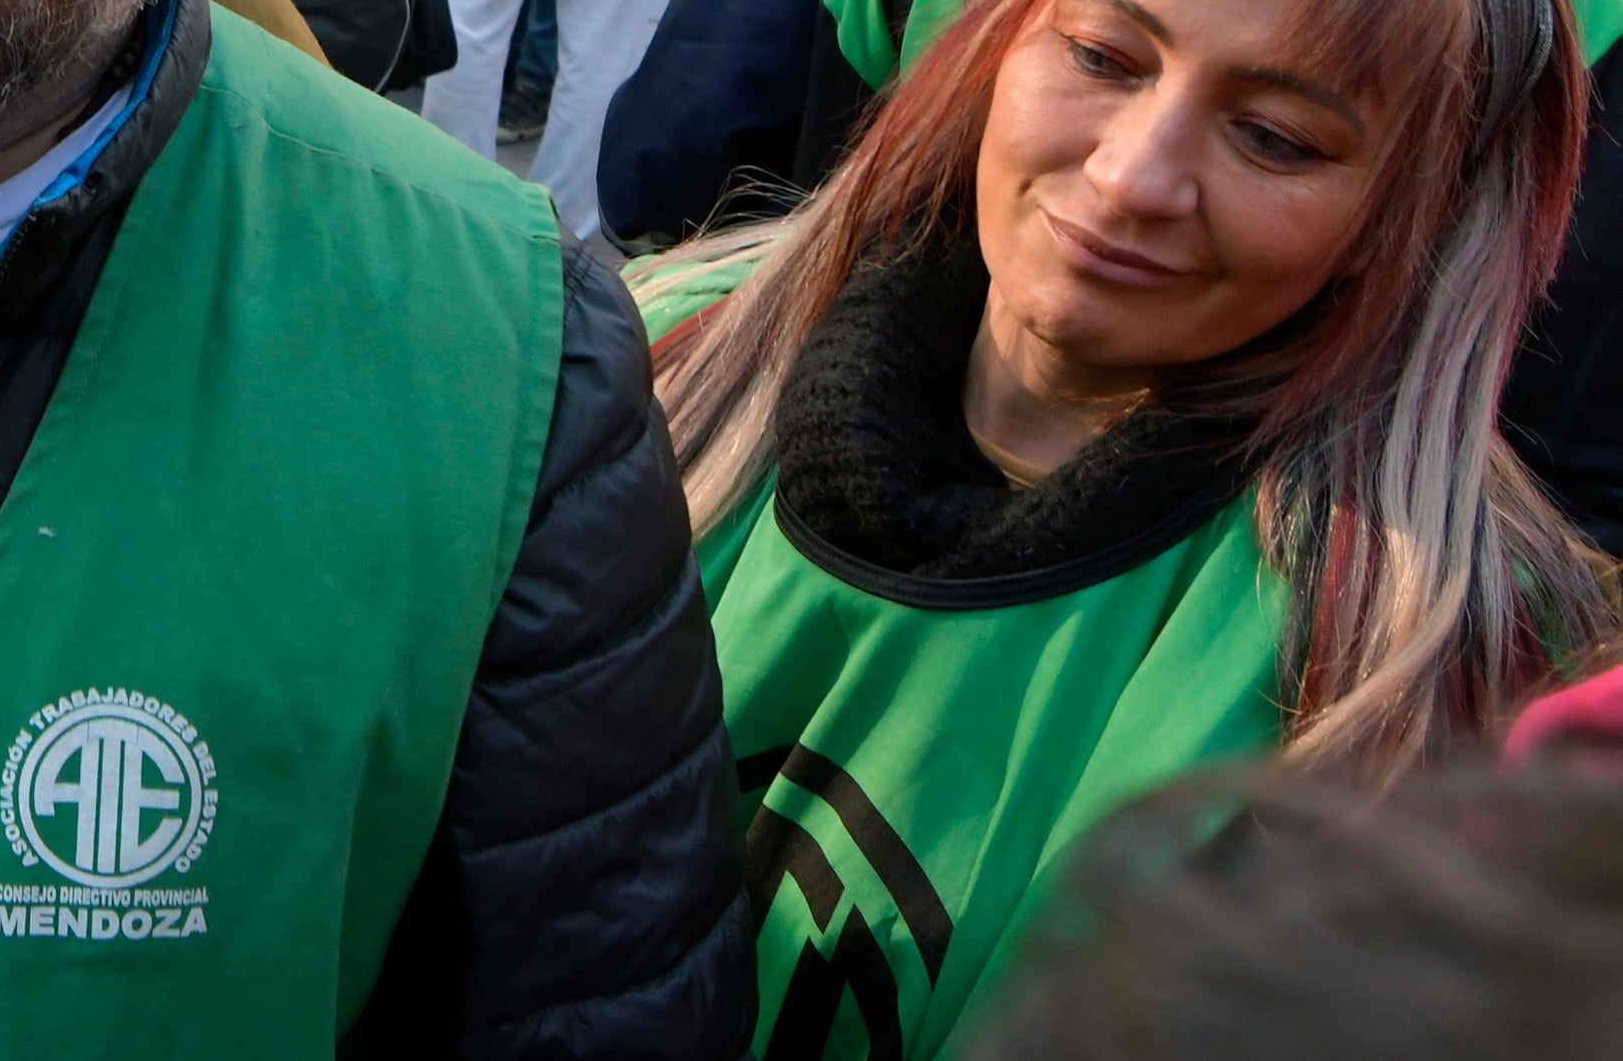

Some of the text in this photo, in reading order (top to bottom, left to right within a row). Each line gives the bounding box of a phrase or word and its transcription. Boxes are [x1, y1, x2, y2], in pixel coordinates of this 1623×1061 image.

[0, 685, 219, 874] ASOCIACIÓN TRABAJADORES DEL ESTADO
[33, 717, 186, 875] ATE
[59, 885, 131, 908] DIRECTIVO
[133, 886, 210, 908] PROVINCIAL
